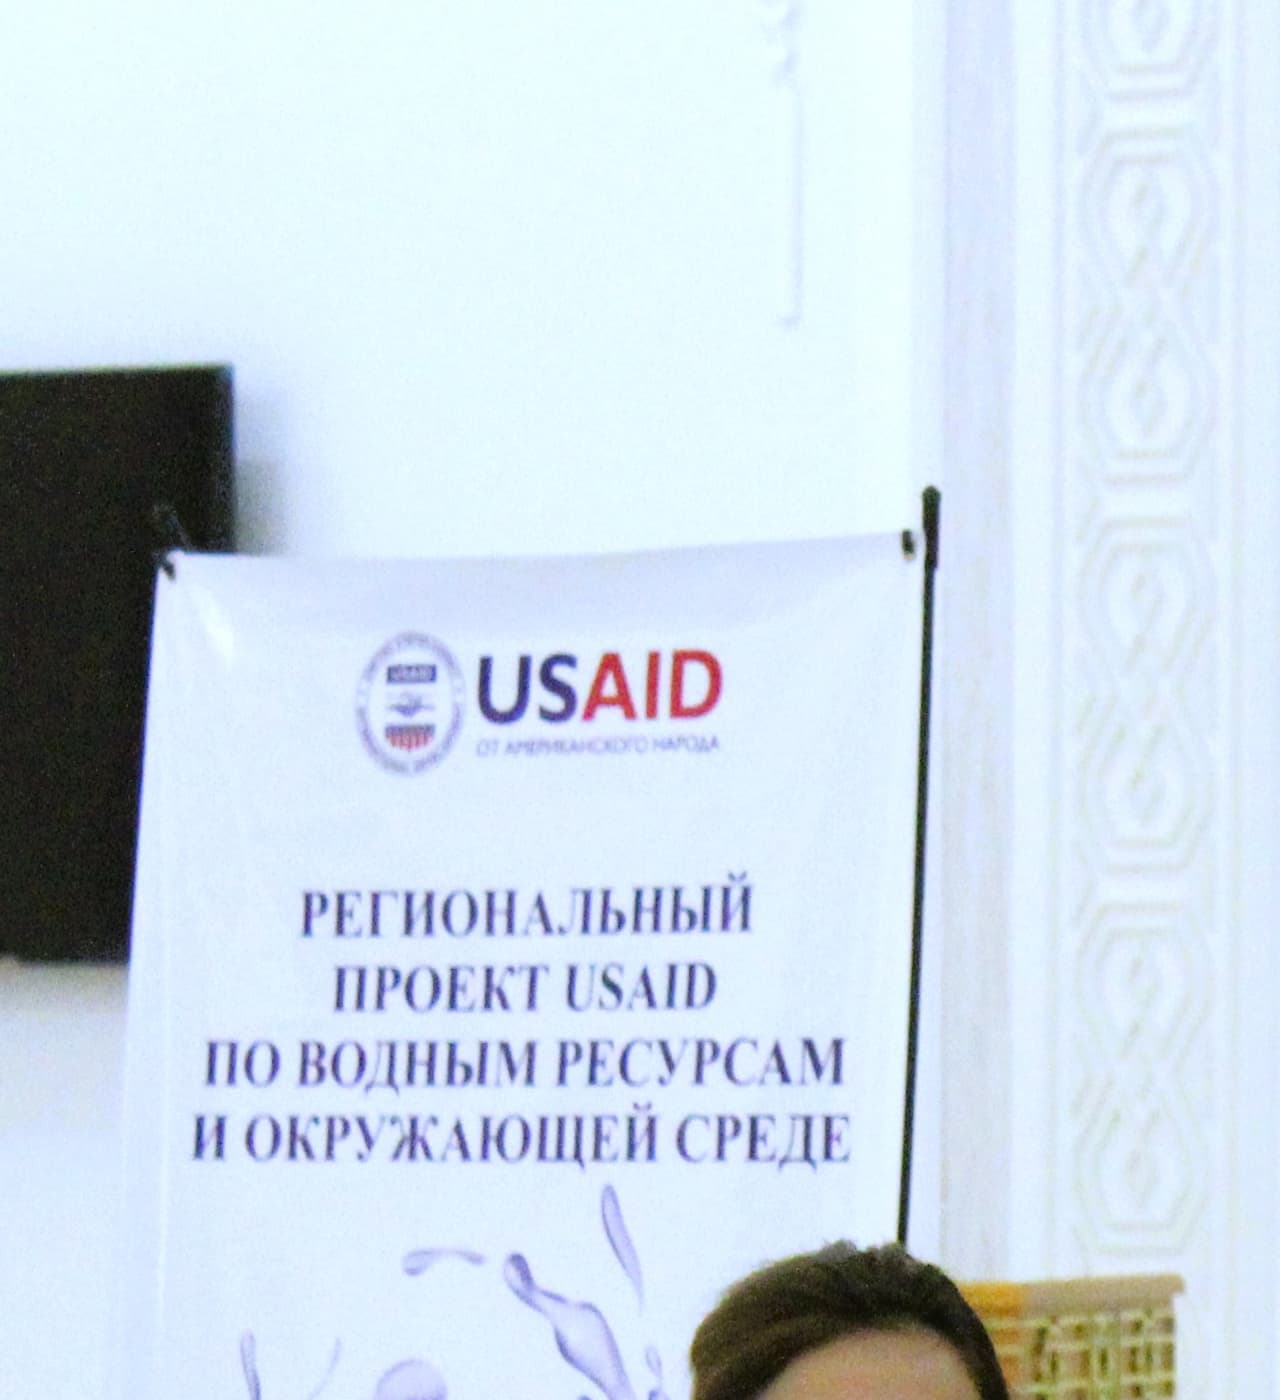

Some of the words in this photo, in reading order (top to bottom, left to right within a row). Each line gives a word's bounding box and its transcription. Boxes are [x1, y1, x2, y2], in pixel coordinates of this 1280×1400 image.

[478, 650, 722, 725] USAID
[475, 738, 500, 758] ОТ
[504, 736, 650, 757] АМЕРИКАНСКОГО
[652, 734, 720, 754] НАРОДА
[302, 871, 752, 938] РЕГИОНАЛЬНЫЙ
[334, 965, 549, 1012] ПРОЕКТ
[566, 963, 717, 1011] USAID
[205, 1040, 281, 1087] ПО
[298, 1040, 537, 1092] ВОДНЫМ
[557, 1038, 844, 1087] РЕСУРСАМ
[193, 1114, 227, 1160] И
[244, 1103, 657, 1168] ОКРУЖАЮЩЕЙ
[675, 1114, 850, 1169] СРЕДЕ
